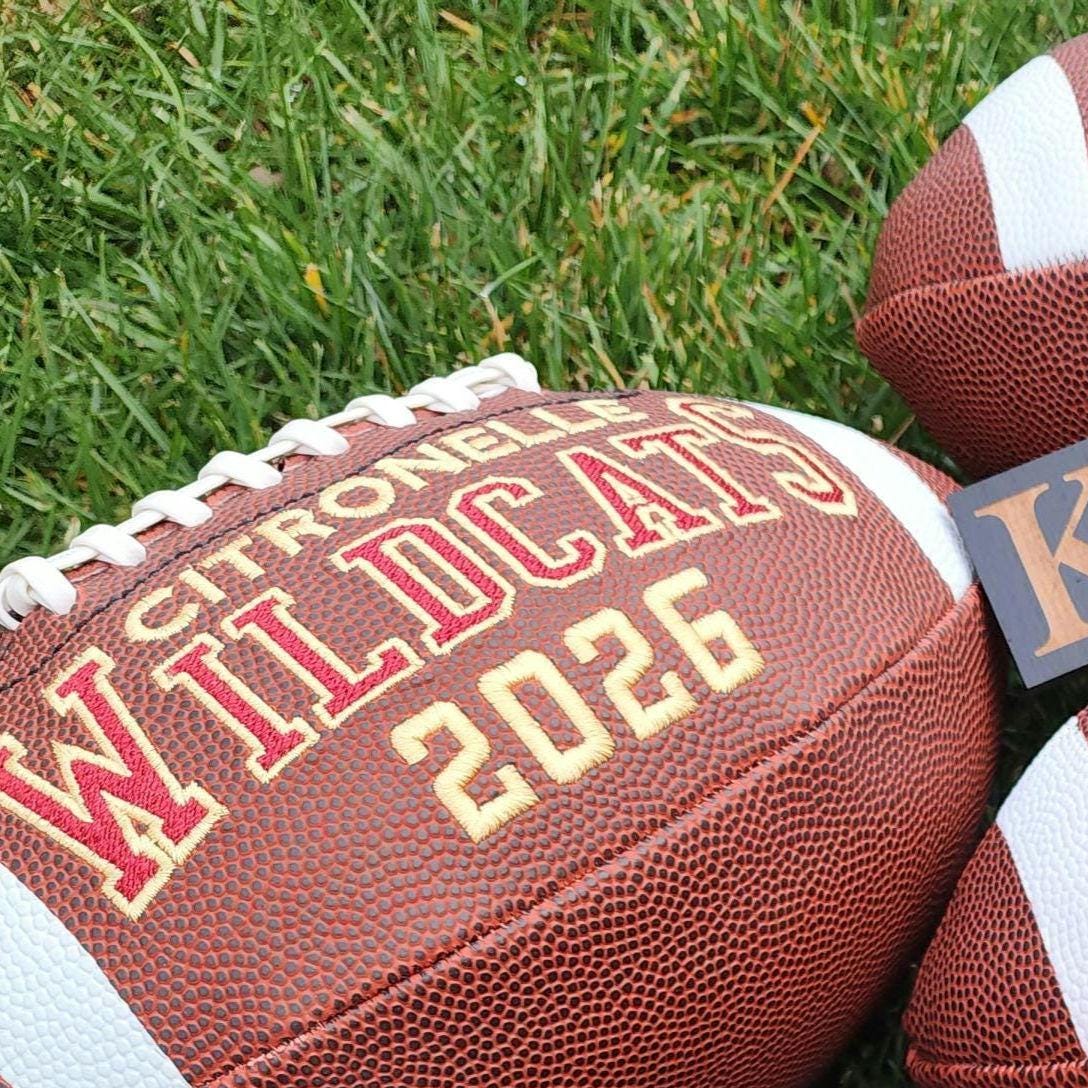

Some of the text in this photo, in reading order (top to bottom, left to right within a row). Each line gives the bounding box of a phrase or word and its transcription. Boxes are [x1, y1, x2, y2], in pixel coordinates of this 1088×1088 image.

[0, 394, 859, 921] WILDCATS
[124, 398, 650, 643] CITRONELLE
[389, 567, 765, 844] 2026
